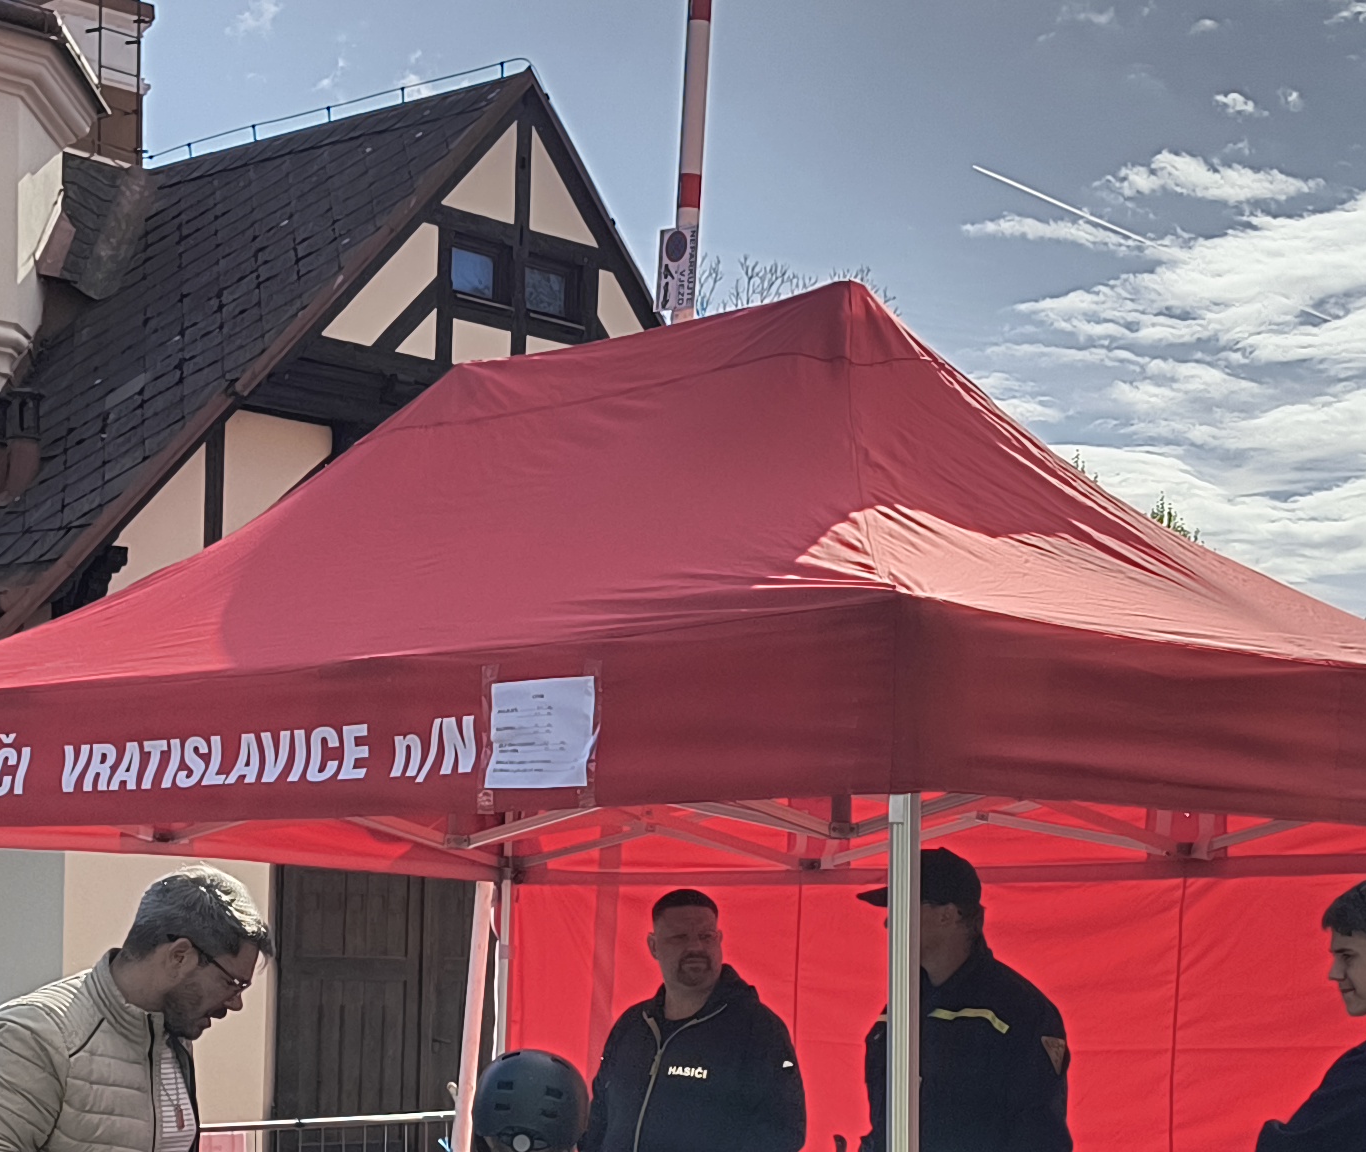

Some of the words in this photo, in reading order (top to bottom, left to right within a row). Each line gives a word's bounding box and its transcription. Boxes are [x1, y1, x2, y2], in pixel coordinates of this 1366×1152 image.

[677, 269, 686, 306] VJEZD
[61, 723, 369, 793] VRATISLAVICE
[389, 715, 476, 783] n/N
[667, 1065, 708, 1079] HASIČI
